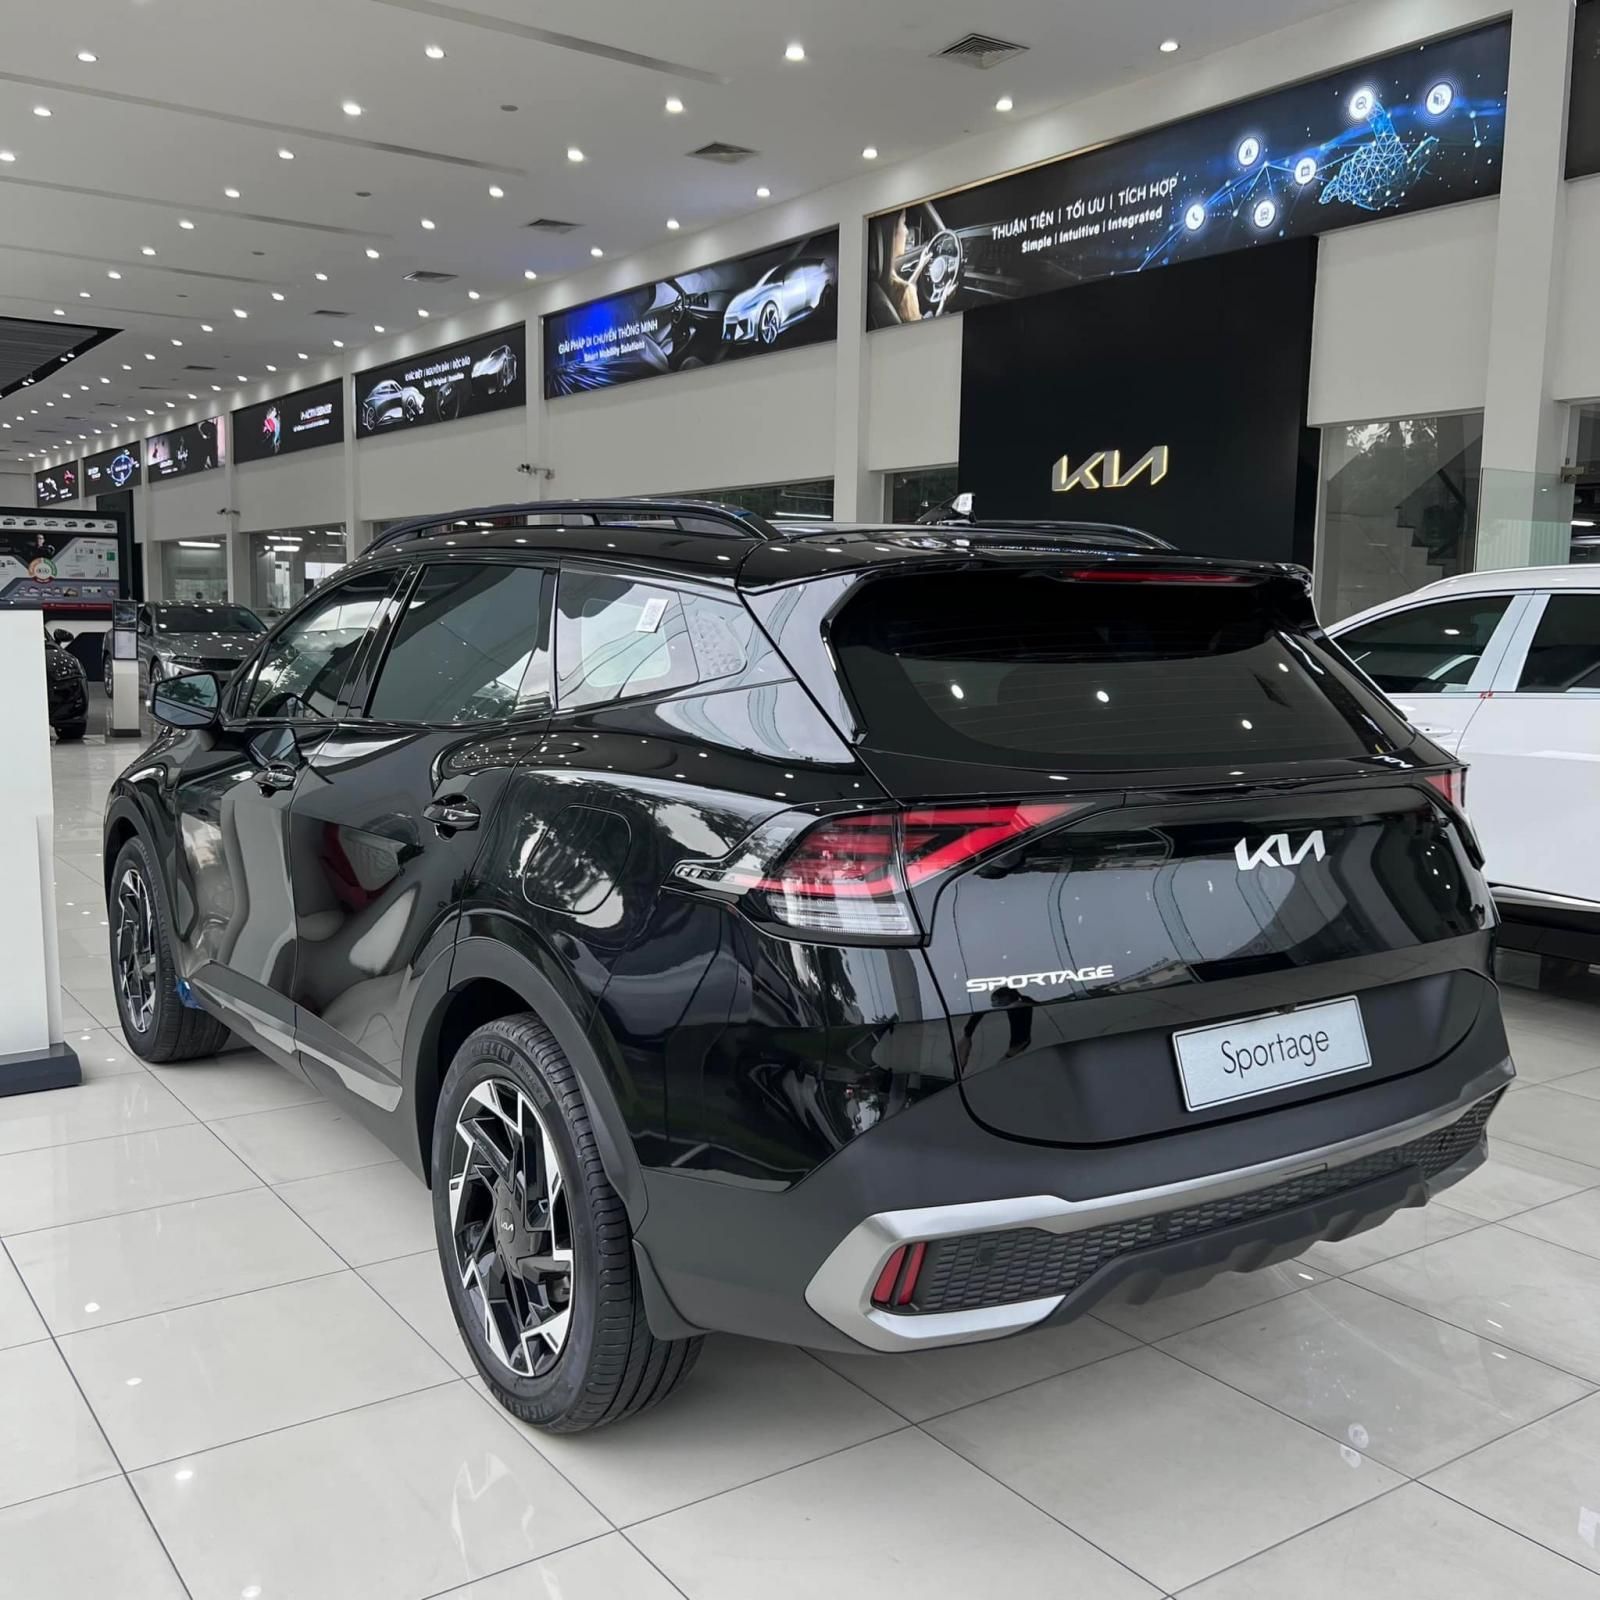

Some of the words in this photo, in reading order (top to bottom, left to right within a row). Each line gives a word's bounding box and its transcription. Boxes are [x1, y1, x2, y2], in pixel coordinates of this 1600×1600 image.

[992, 219, 1027, 240] THUẬN
[1030, 210, 1054, 230] TIỆN
[1066, 198, 1085, 221] TỐI
[1088, 195, 1106, 215] ƯU
[1118, 186, 1147, 206] TÍCH
[1149, 176, 1178, 198] HỢP
[1021, 235, 1052, 253] Simple
[1059, 224, 1100, 243] Intuitive
[1108, 205, 1163, 231] Integrated
[1052, 445, 1168, 491] KIA
[1234, 830, 1326, 871] KIA
[966, 964, 1115, 994] SPORTAGE
[1220, 1028, 1330, 1079] Sportage
